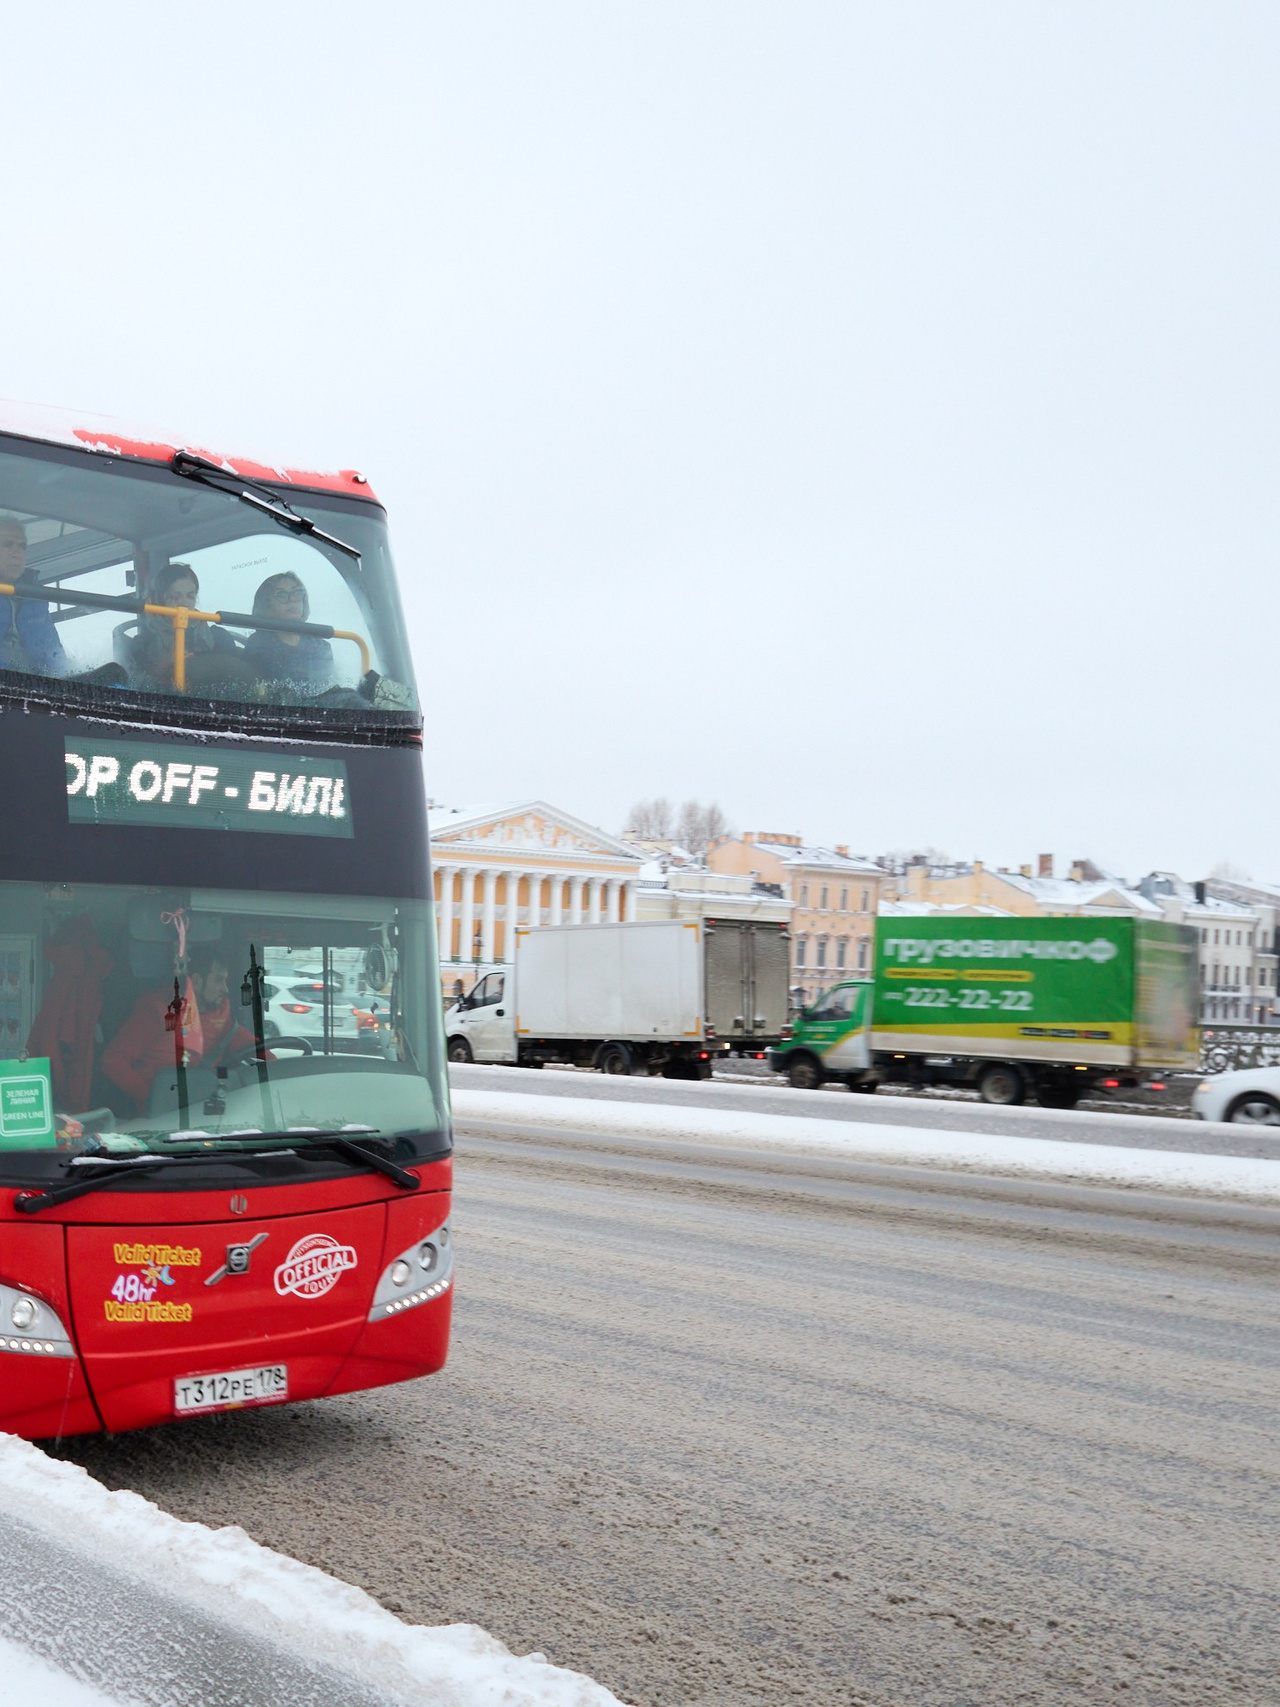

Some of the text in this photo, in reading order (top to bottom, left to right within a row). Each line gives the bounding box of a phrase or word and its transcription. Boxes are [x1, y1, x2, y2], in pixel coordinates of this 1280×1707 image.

[128, 760, 219, 805] OFF
[903, 987, 1034, 1012] 222-22-22
[5, 1088, 39, 1098] ЗЕЛЕНАЯ
[9, 1096, 36, 1105] ЛИНИЯ
[2, 1110, 45, 1120] GREEN LINE
[113, 1243, 202, 1266] Valid Ticket
[283, 1251, 349, 1286] OFFICIAL
[111, 1274, 157, 1302] 48hr
[304, 1273, 335, 1293] TOUR
[104, 1300, 193, 1322] Valid Ticket
